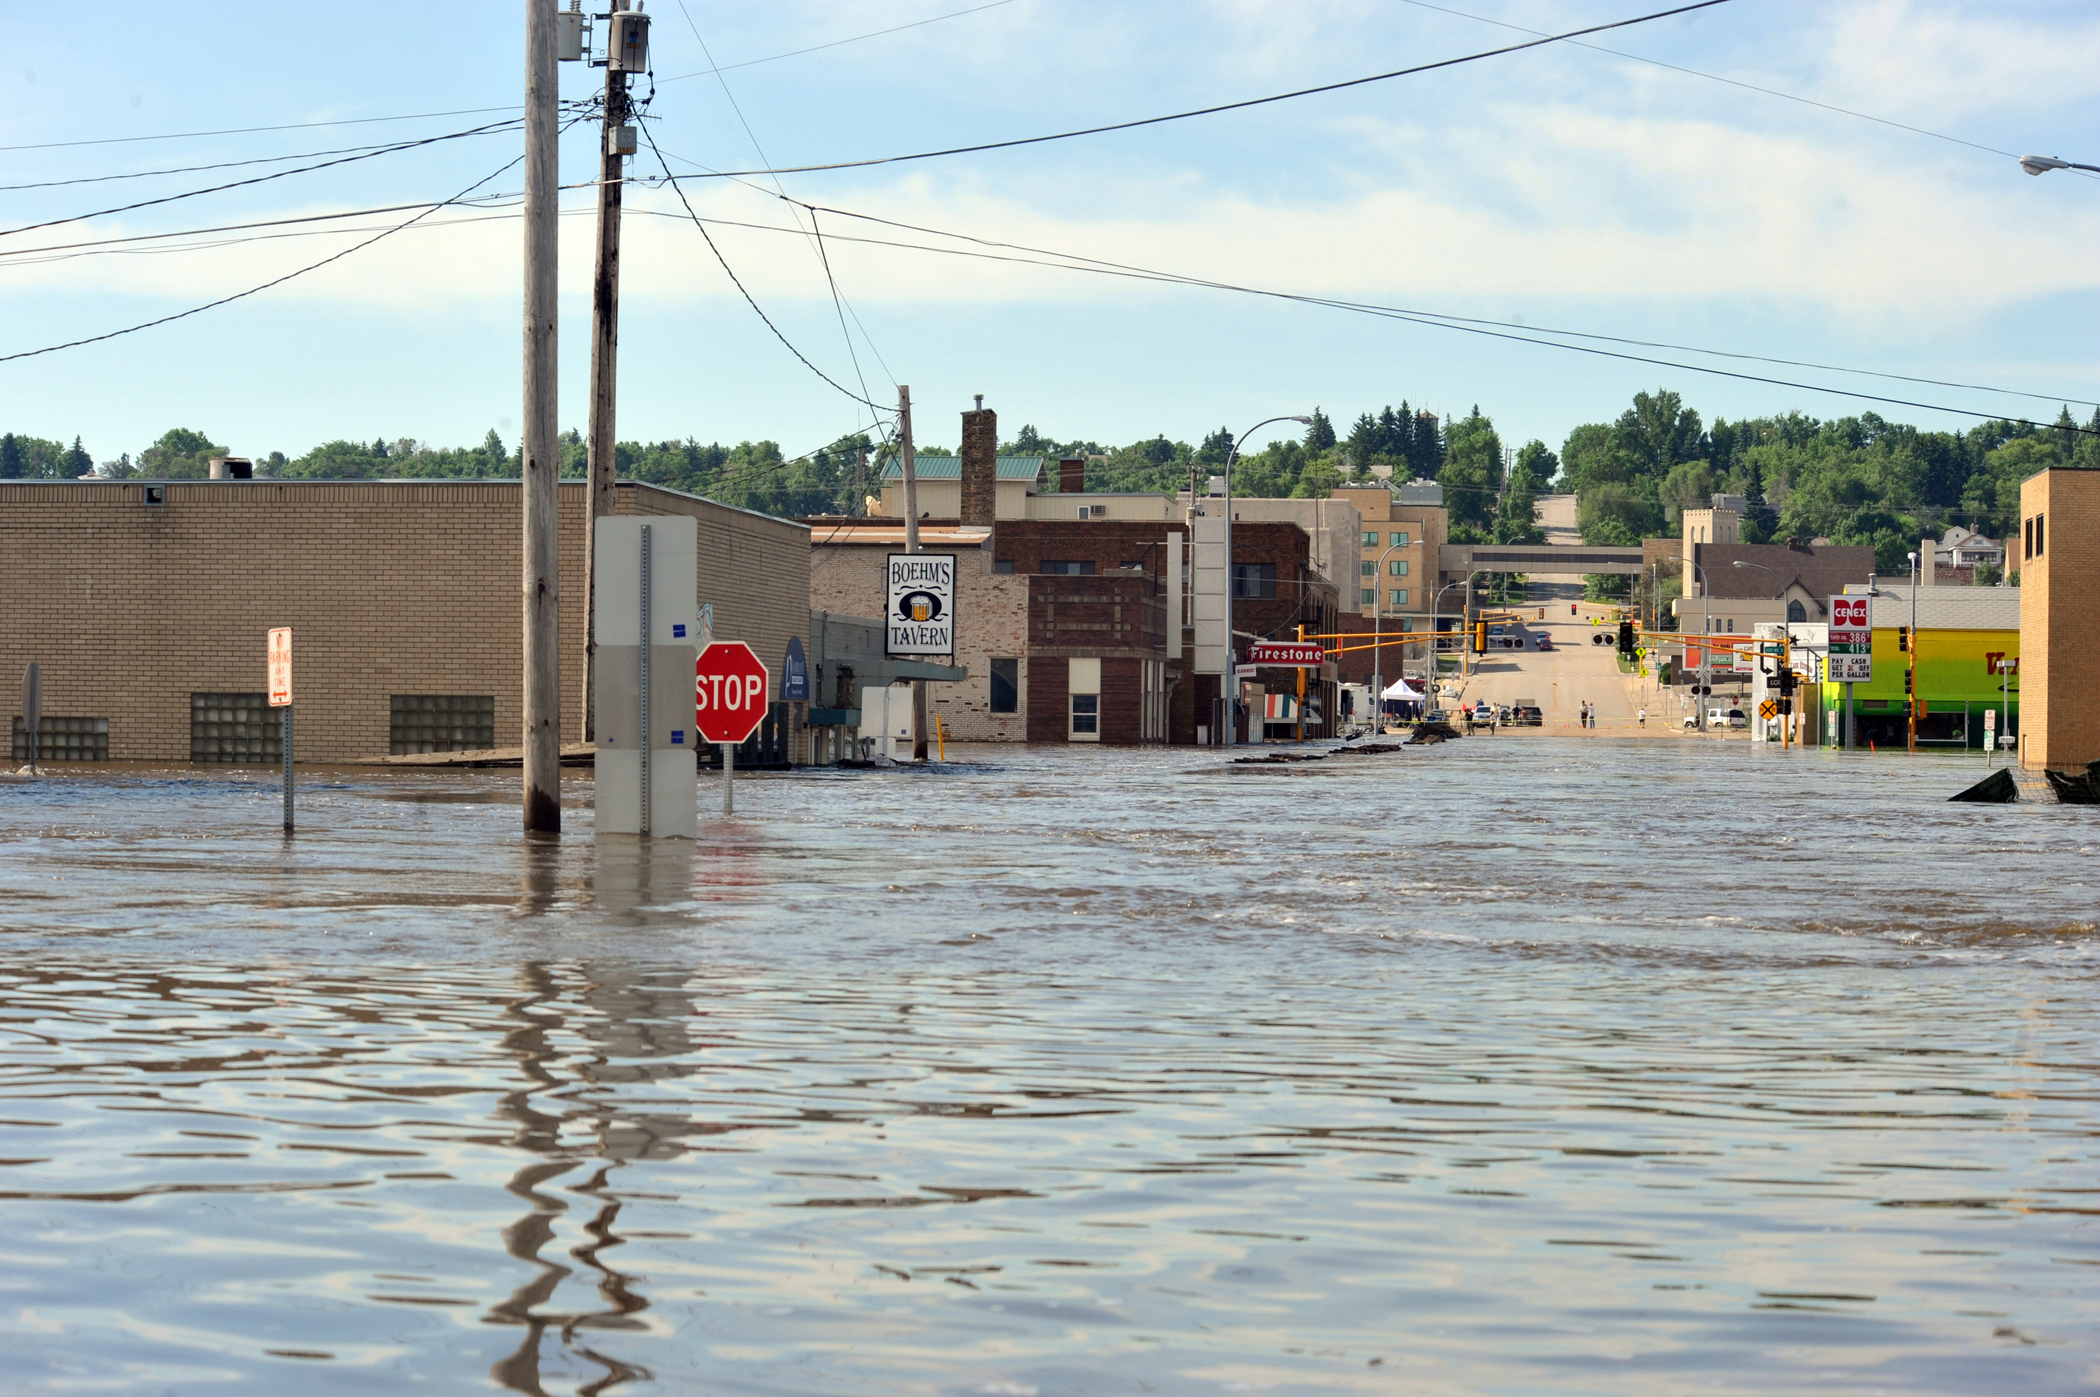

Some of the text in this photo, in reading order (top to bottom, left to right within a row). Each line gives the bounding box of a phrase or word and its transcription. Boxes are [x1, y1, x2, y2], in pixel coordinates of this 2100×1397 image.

[892, 562, 950, 585] BOEHM'S
[1835, 608, 1866, 617] CENEX
[276, 634, 283, 648] NO
[891, 624, 948, 647] TAVERN
[1849, 632, 1866, 643] 386
[1249, 646, 1322, 661] Firestone
[1849, 643, 1866, 654] 413
[270, 649, 290, 664] PARKING
[275, 667, 284, 675] ANY
[274, 676, 285, 687] TIME
[696, 674, 762, 711] STOP
